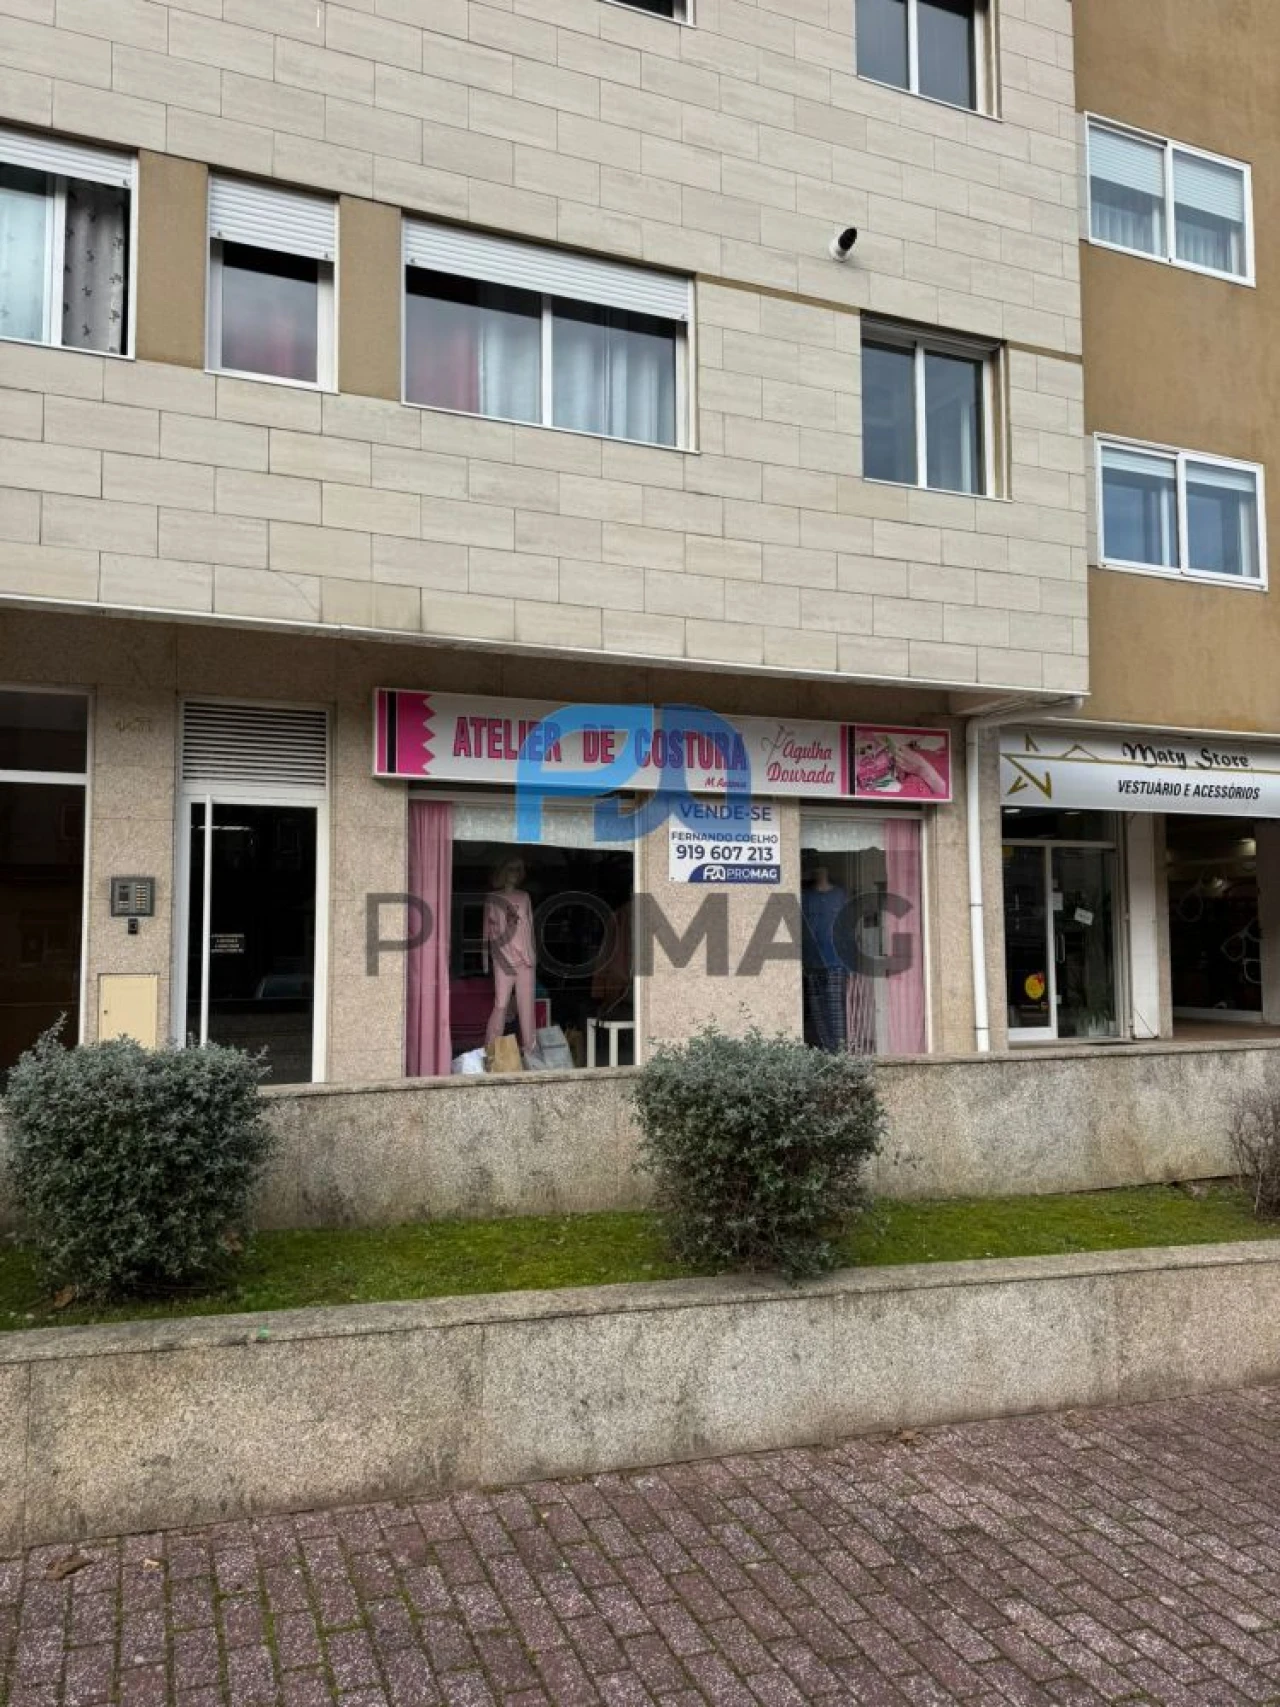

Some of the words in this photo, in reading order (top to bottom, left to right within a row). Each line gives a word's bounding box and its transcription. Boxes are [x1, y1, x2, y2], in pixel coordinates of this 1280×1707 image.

[453, 716, 562, 763] ATELIER
[583, 723, 616, 764] DE
[634, 728, 747, 771] COSTURA
[782, 739, 832, 764] Agulha
[1122, 742, 1187, 770] Maty
[1195, 747, 1250, 770] Store
[766, 763, 836, 785] Dourada
[1118, 778, 1182, 797] VESTUÁRIO
[1183, 783, 1191, 797] E
[1192, 781, 1261, 801] ACESSÓRIOS
[679, 803, 773, 822] VENDE-SE
[671, 830, 734, 843] FERNANDO
[735, 832, 779, 844] COELHO
[676, 844, 706, 860] 919
[710, 846, 743, 861] 607
[746, 846, 774, 862] 213
[726, 867, 778, 879] PROMAG
